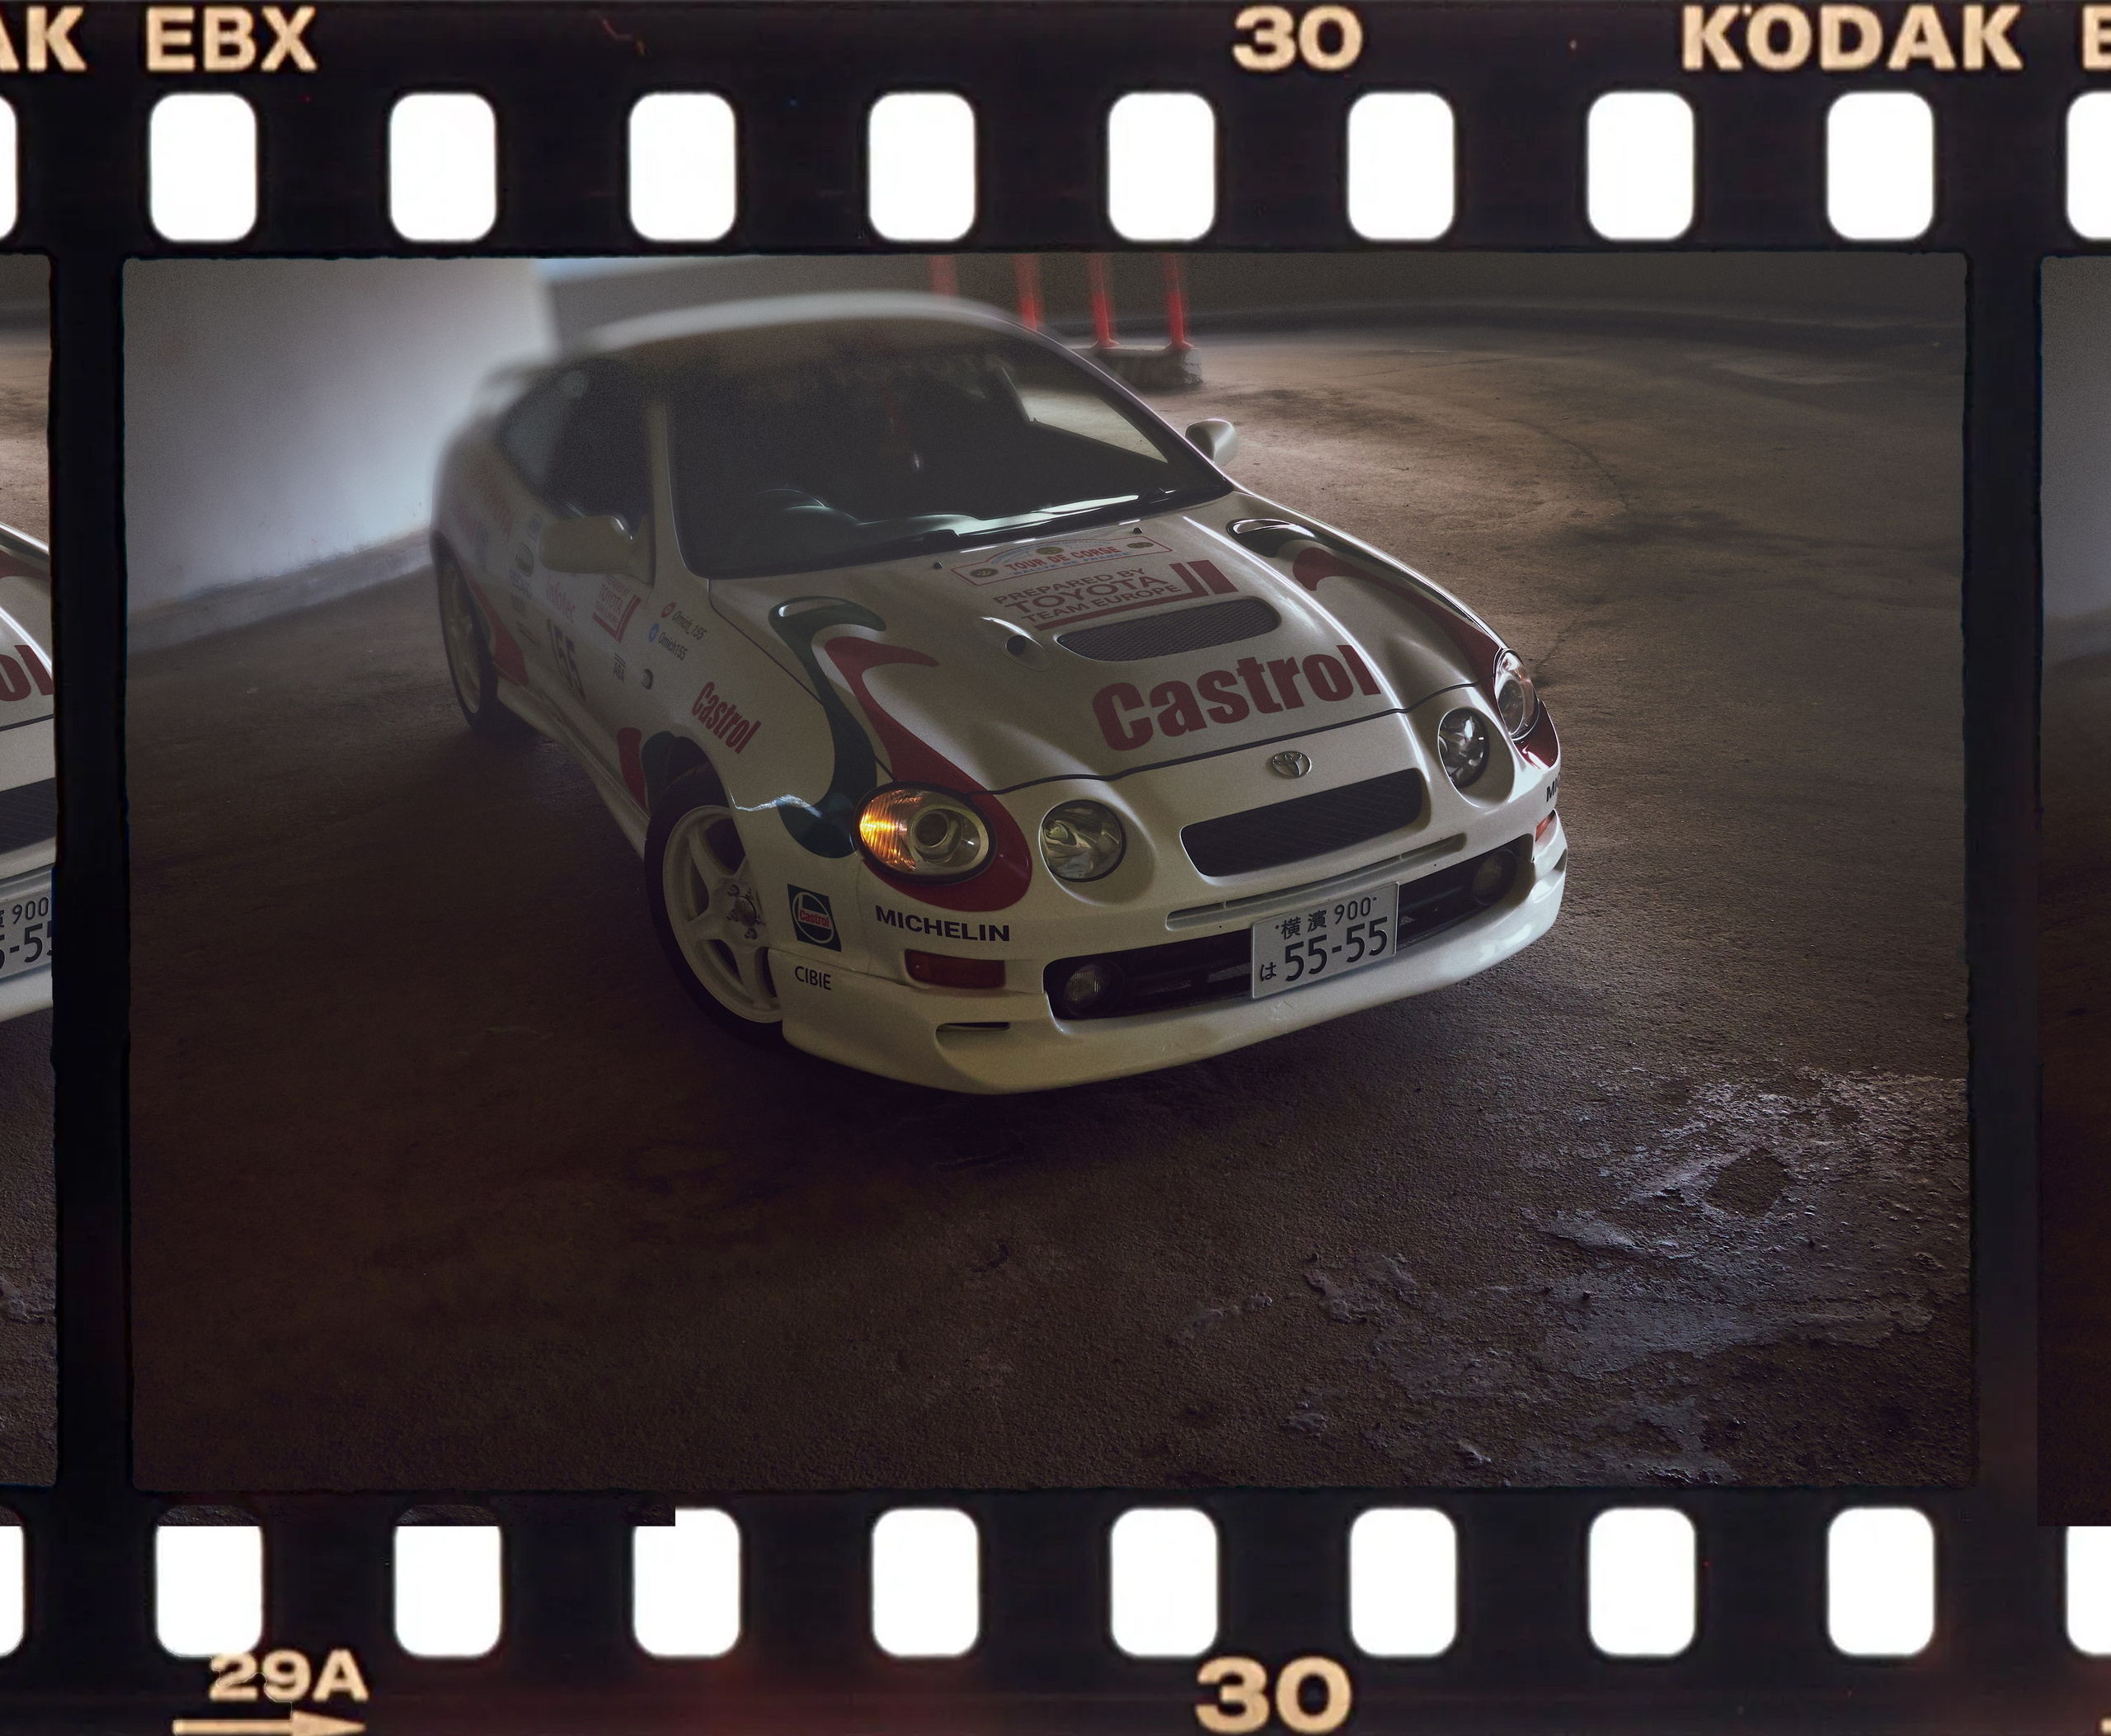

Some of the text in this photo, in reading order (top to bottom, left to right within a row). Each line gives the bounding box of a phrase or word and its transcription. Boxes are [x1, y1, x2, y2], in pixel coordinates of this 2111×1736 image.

[145, 5, 318, 73] EBX
[1232, 4, 1363, 73] 30
[1681, 3, 2025, 70] KODAK
[1004, 557, 1046, 572] TOUR
[1047, 553, 1071, 565] DE
[1071, 545, 1122, 561] CORSE
[992, 567, 1146, 605] PREPARED BY
[1004, 574, 1169, 614] TOYOTA
[1020, 584, 1182, 624] TEAM EUROPE
[671, 609, 708, 641] Omich_155
[658, 630, 689, 661] Omich155
[1092, 643, 1382, 751] Castrol
[691, 680, 762, 755] Castrol
[12, 896, 49, 925] 900
[799, 908, 830, 929] Castrol
[874, 905, 1010, 942] MICHELIN
[1280, 896, 1371, 941] 横濱 900
[1259, 916, 1389, 982] は 55-55
[794, 964, 832, 990] CIBIE
[209, 1646, 369, 1703] 29A
[1195, 1654, 1352, 1734] 30
